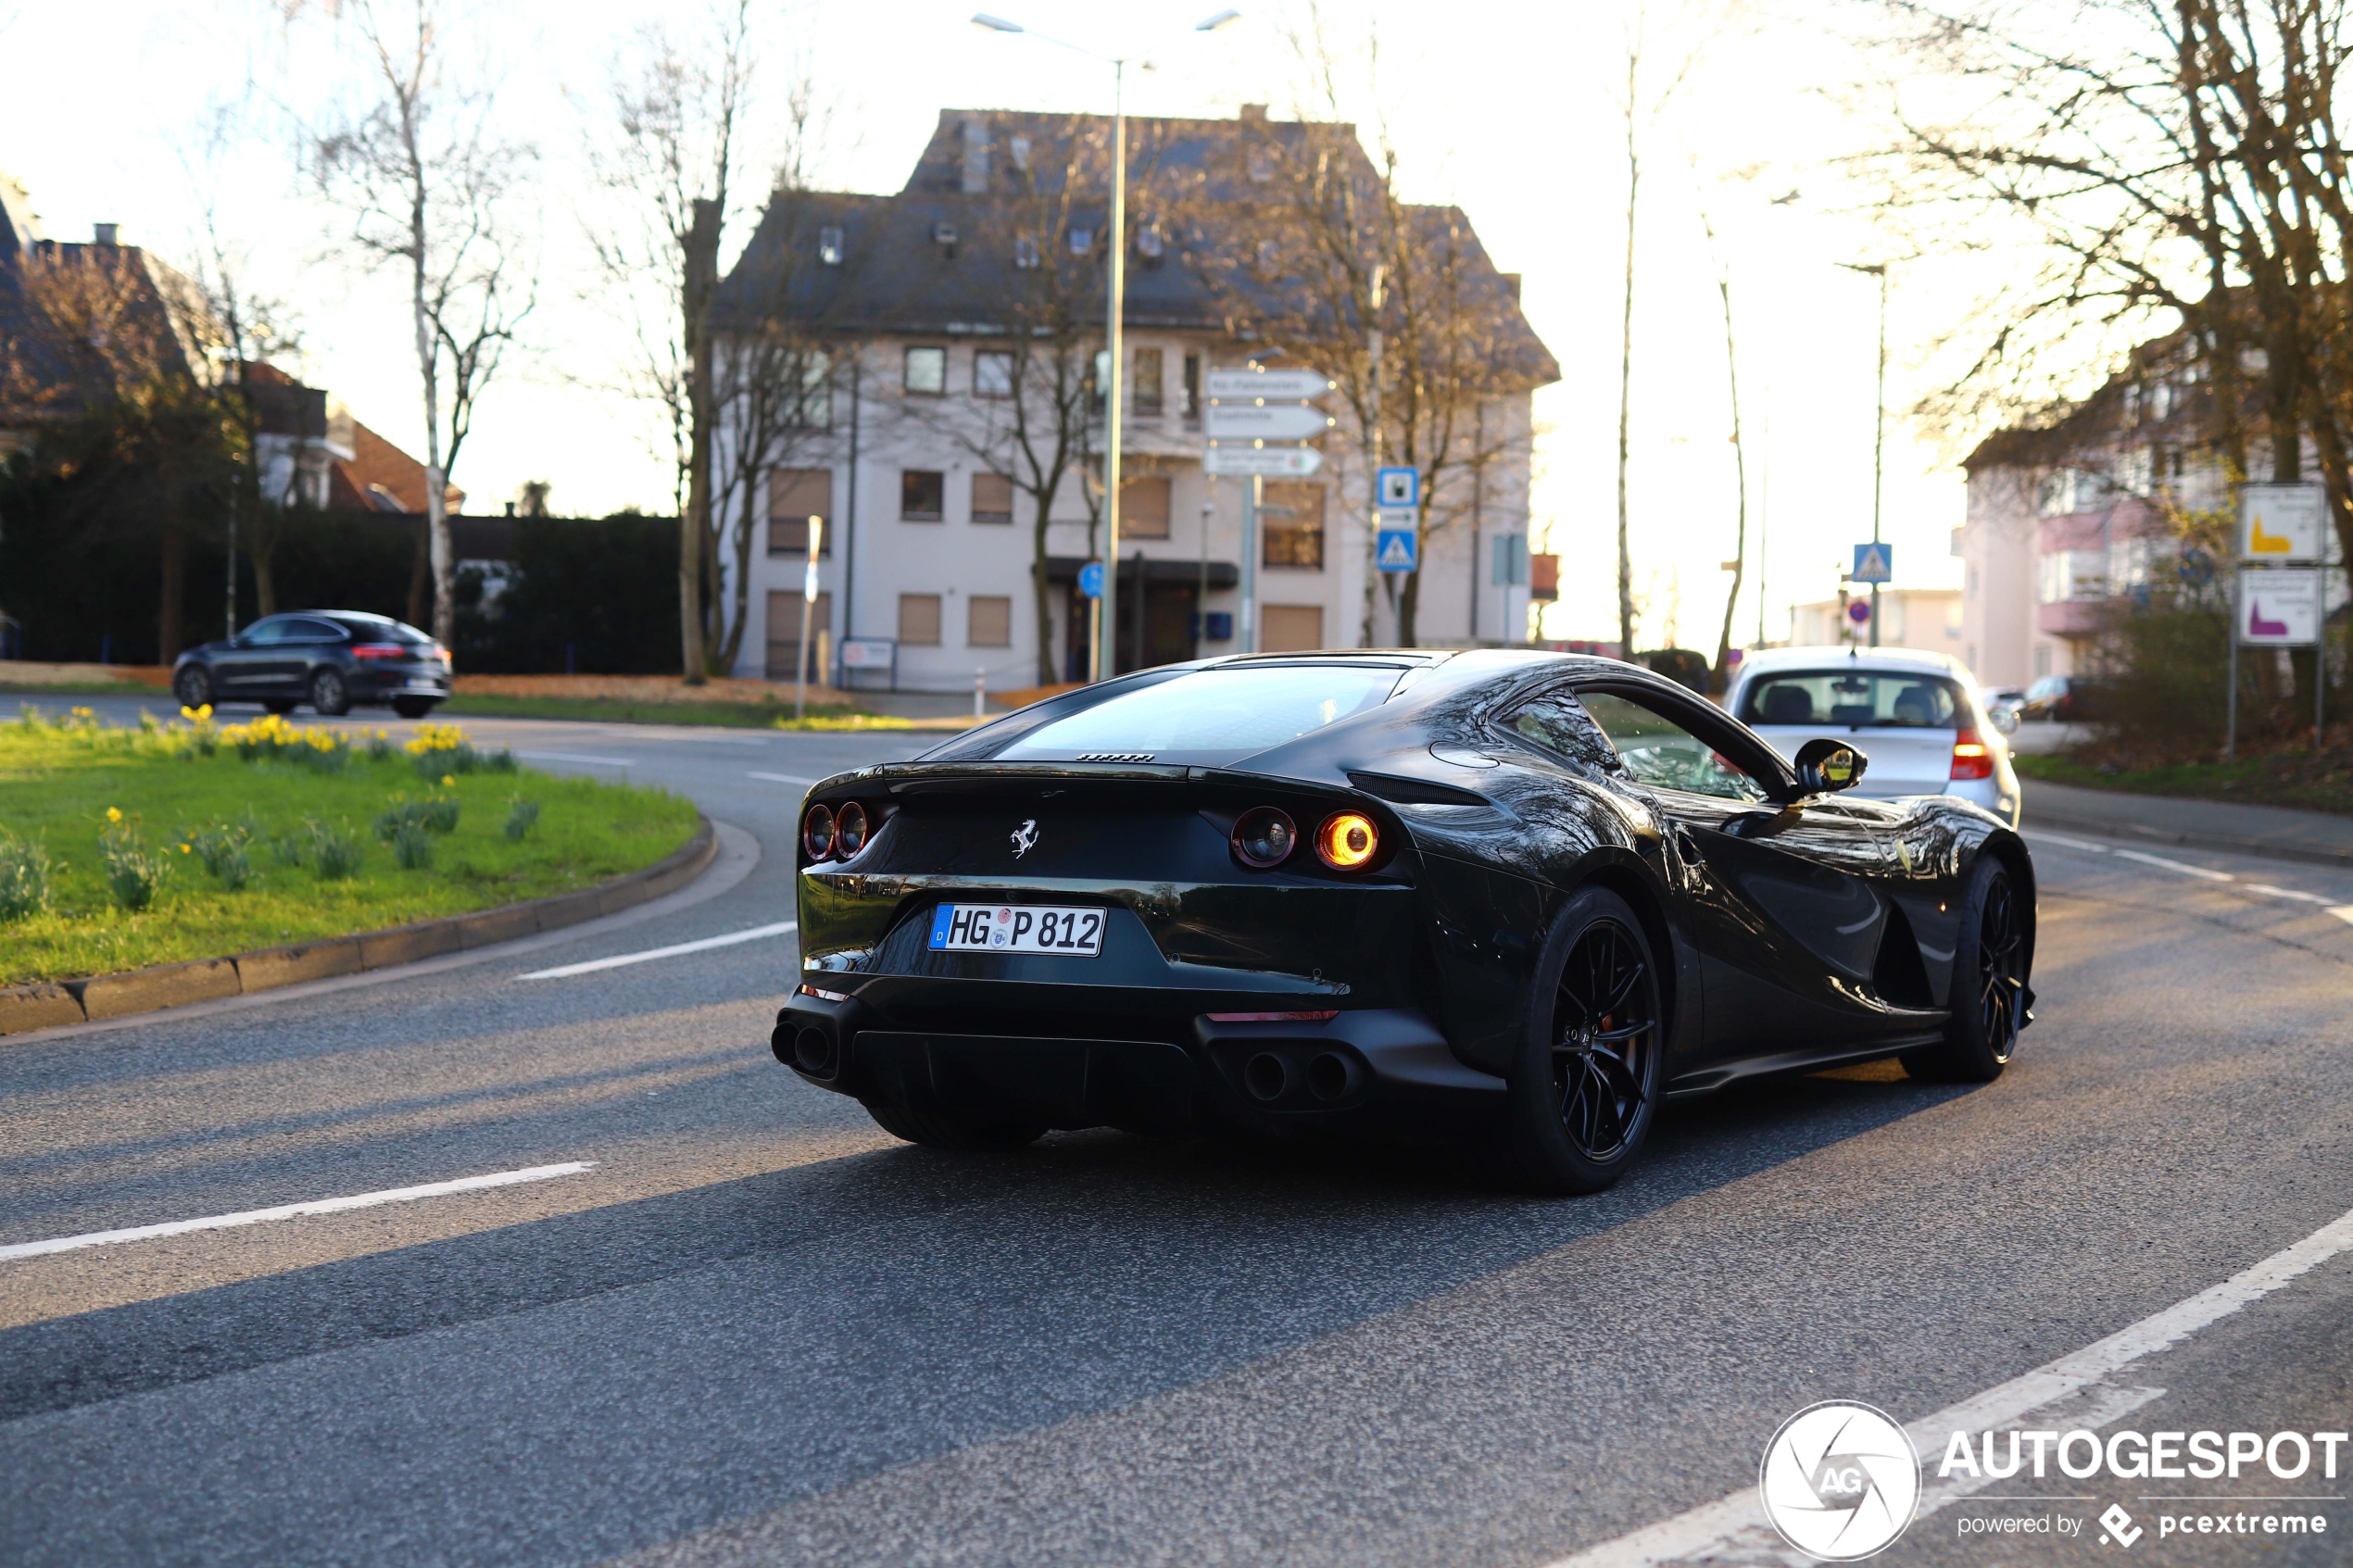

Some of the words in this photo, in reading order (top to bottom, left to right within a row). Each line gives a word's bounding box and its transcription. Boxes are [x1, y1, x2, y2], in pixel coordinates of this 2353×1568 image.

[936, 931, 944, 941] D
[949, 910, 991, 945] HG
[1011, 911, 1033, 946] P
[1038, 912, 1101, 949] 812
